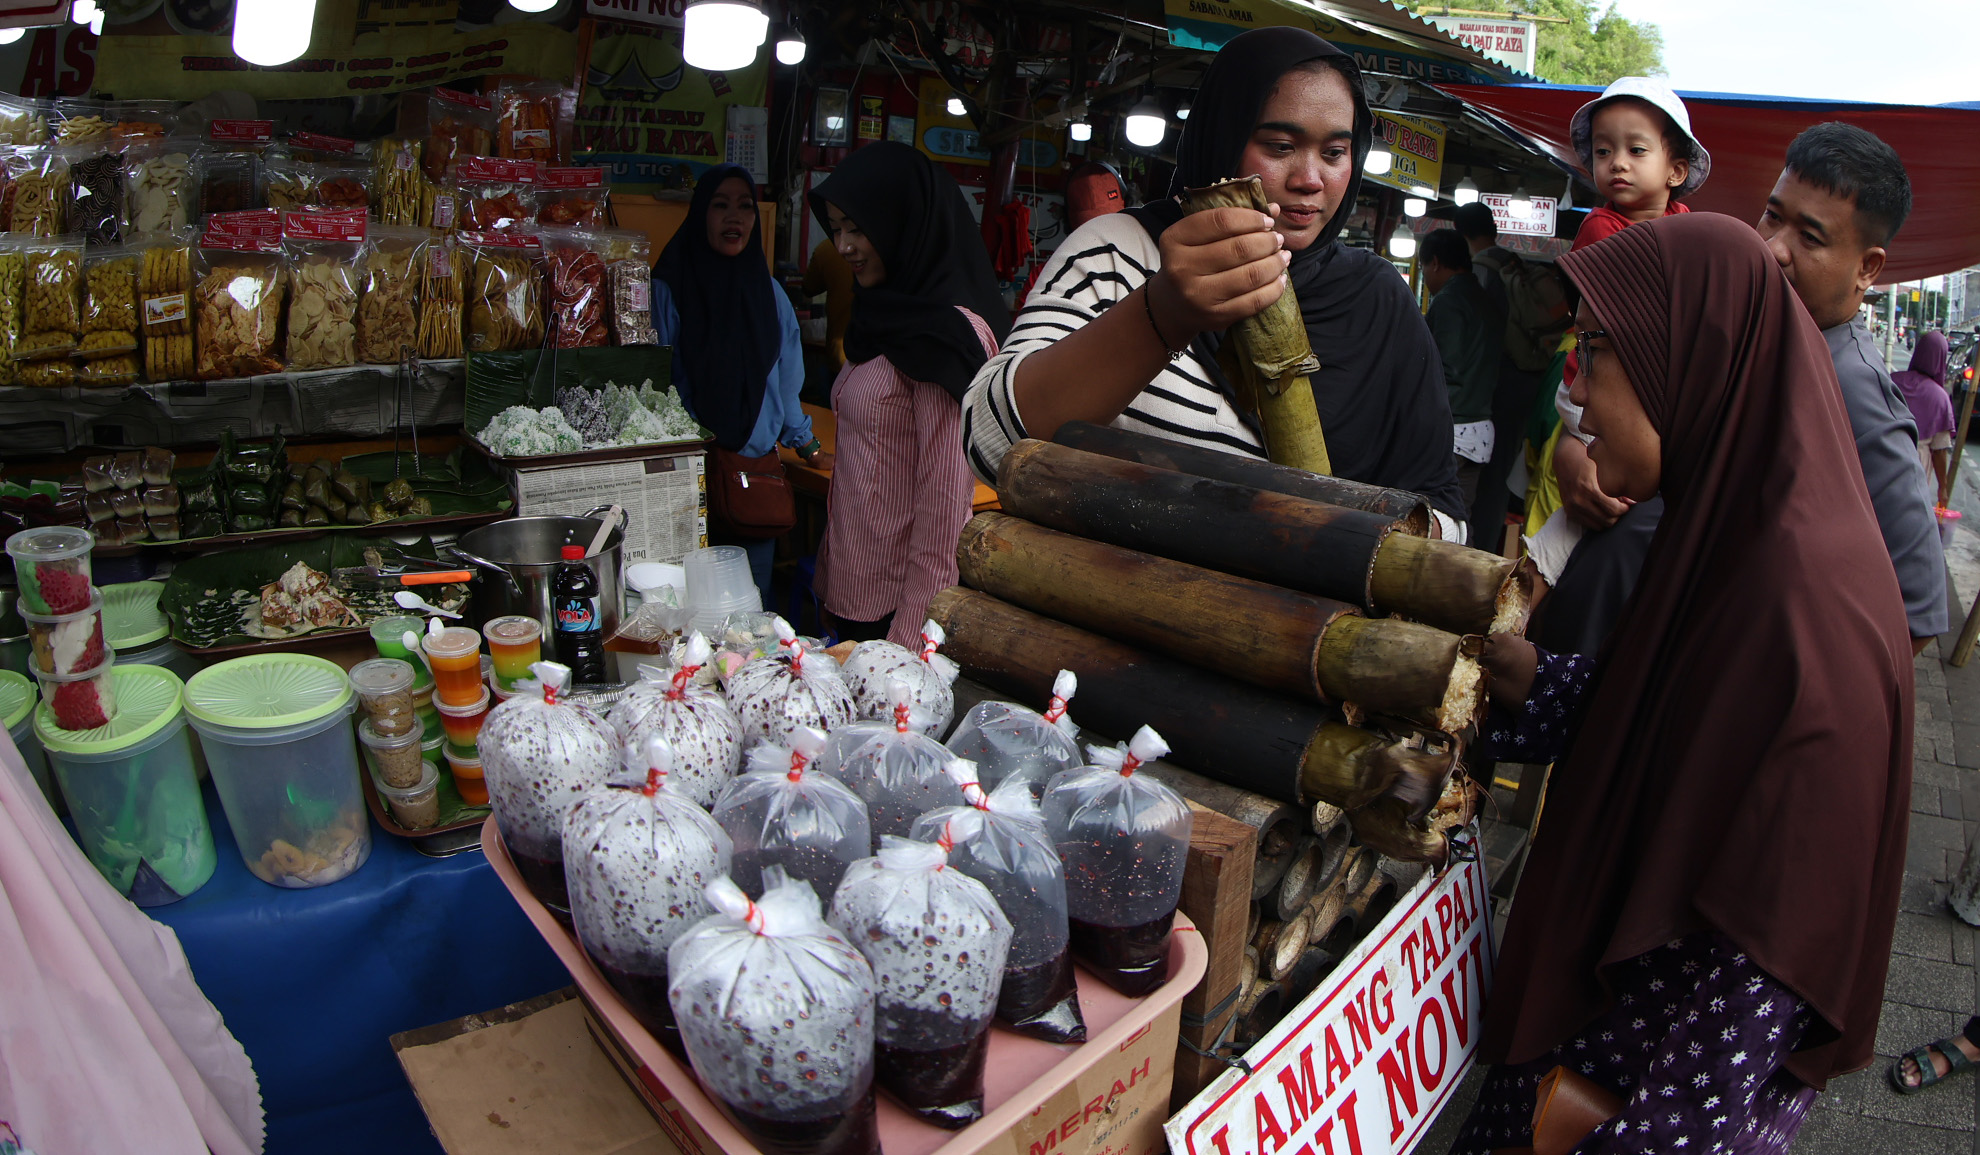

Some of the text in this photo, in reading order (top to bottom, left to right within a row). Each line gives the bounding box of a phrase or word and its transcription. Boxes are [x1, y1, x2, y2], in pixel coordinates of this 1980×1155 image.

[648, 0, 686, 18] NO
[1495, 36, 1524, 53] RAYA
[573, 126, 640, 152] APAU
[646, 128, 718, 156] RAYA
[1399, 125, 1438, 162] RAYA
[635, 162, 673, 177] TIG
[1511, 221, 1548, 232] TELOR
[633, 550, 646, 559] Dua
[557, 608, 592, 623] VOLA
[1401, 864, 1478, 997] TAPAI
[1376, 931, 1486, 1145] NOVI
[1029, 1057, 1150, 1155] MERAH
